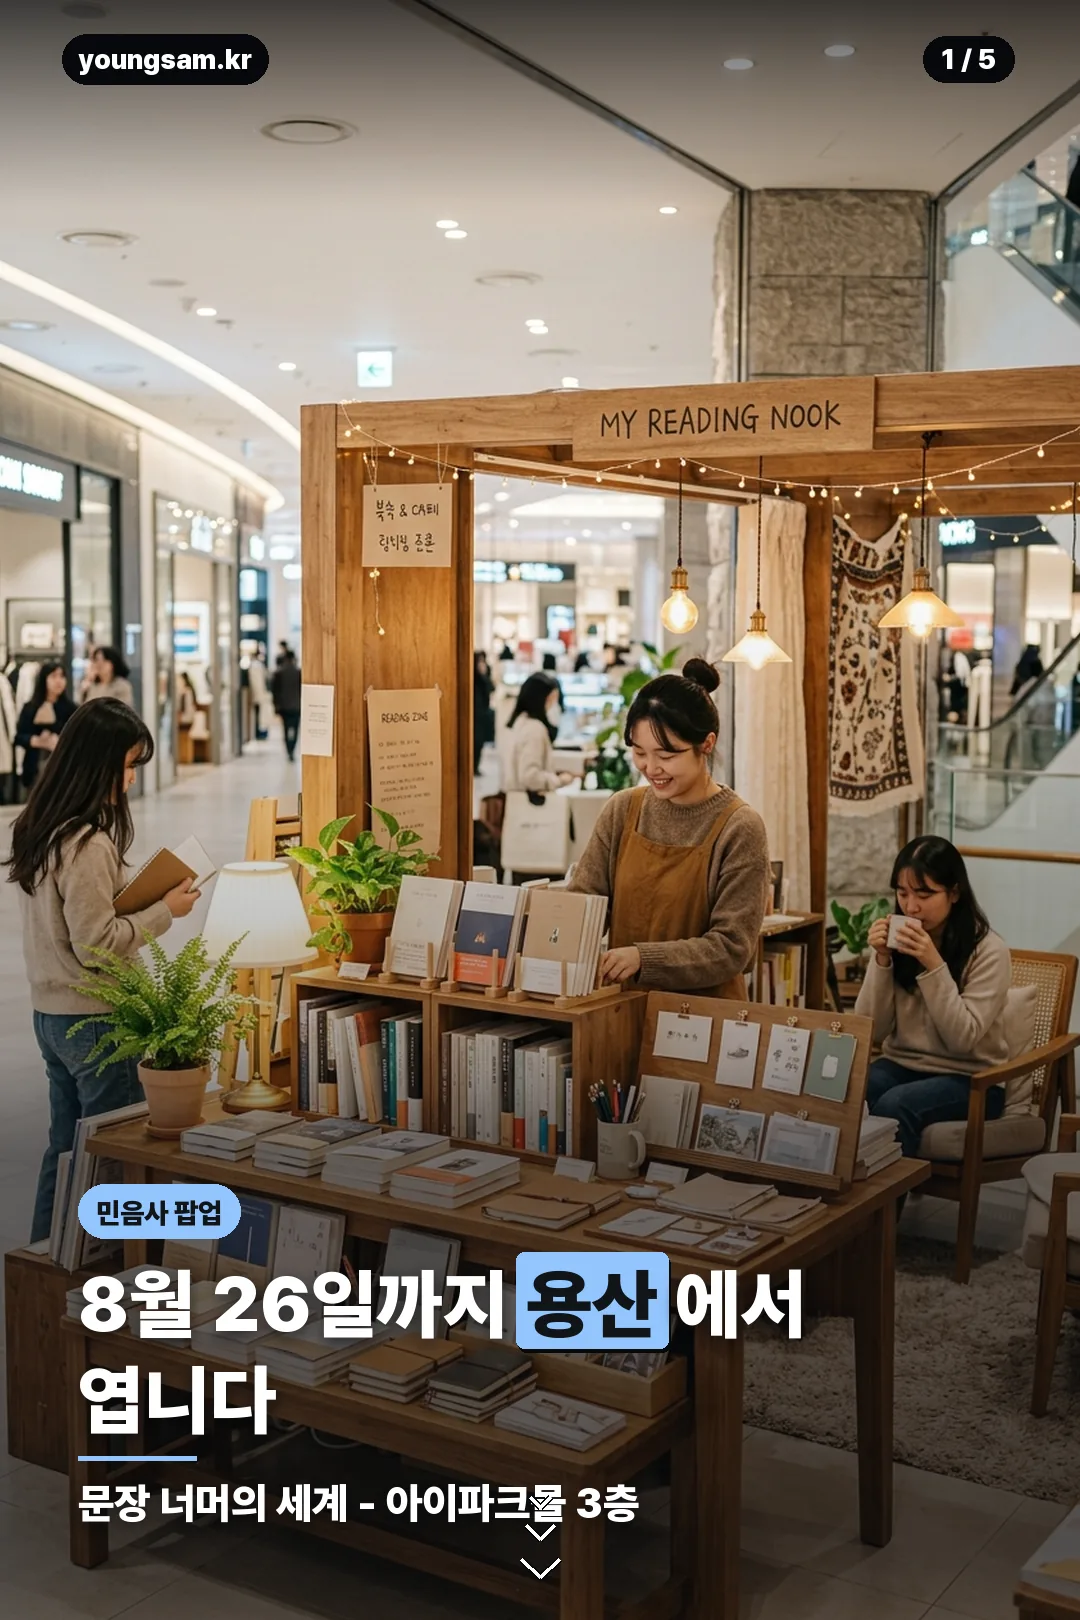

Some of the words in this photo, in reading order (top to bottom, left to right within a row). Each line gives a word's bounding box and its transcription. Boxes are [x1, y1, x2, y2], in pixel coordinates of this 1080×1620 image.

[601, 410, 637, 439] MY
[648, 403, 759, 438] READING
[771, 399, 841, 430] NOOK
